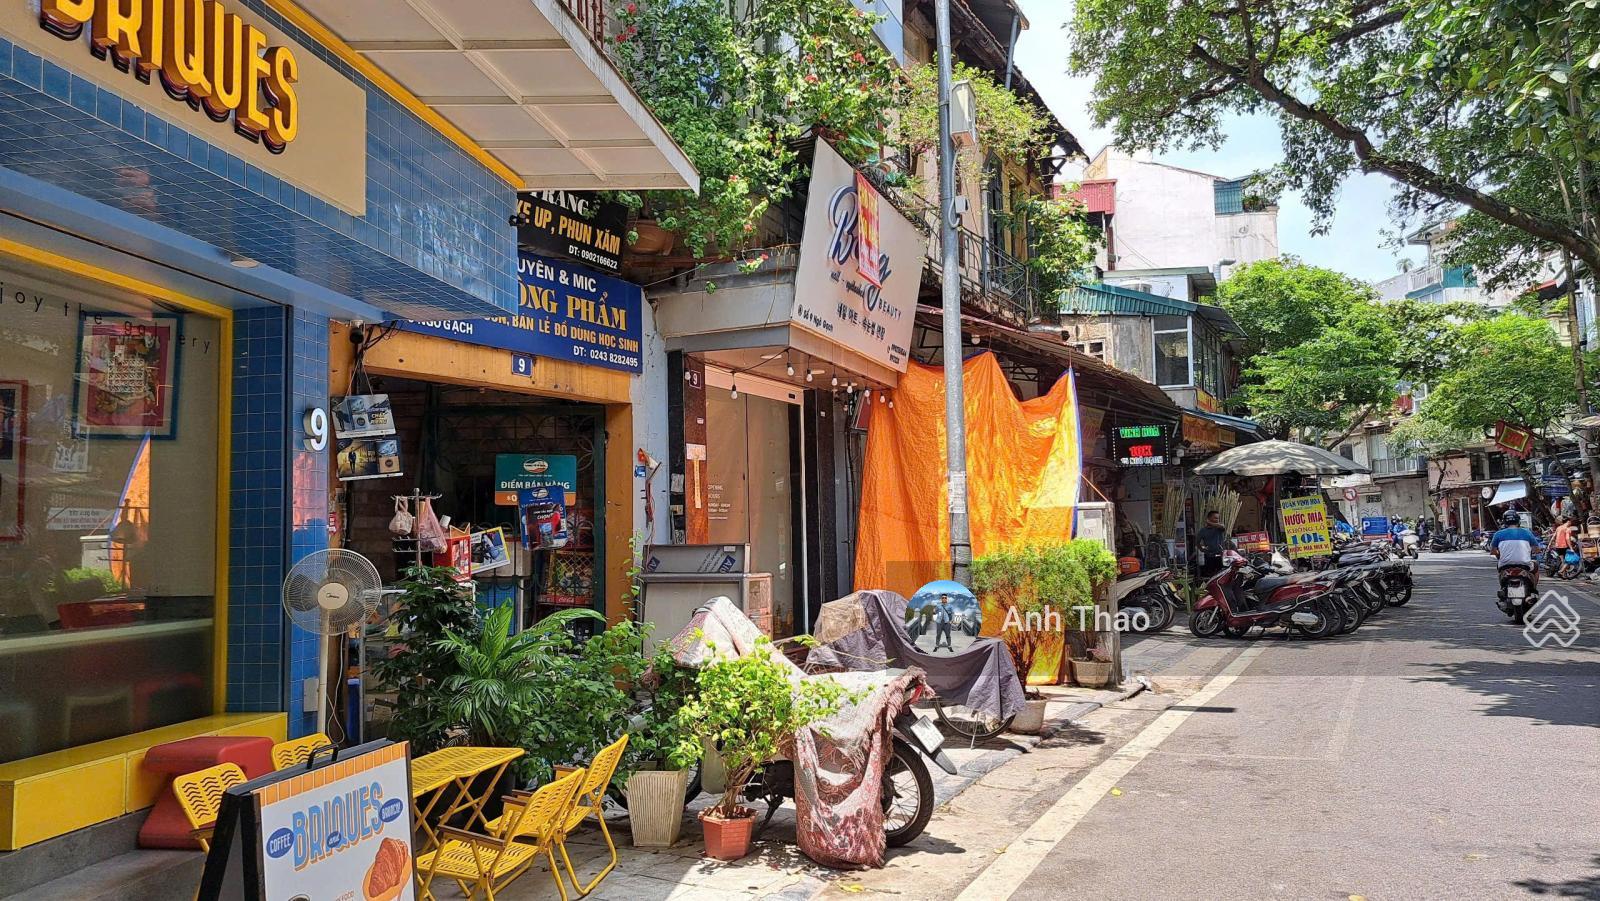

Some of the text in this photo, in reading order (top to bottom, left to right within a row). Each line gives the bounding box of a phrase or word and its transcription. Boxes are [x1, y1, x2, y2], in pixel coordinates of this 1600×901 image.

[50, 0, 298, 143] RIQUES
[530, 190, 589, 216] RANG
[559, 215, 592, 245] PHUN
[595, 228, 621, 256] XĂM
[558, 269, 569, 286] &
[573, 273, 597, 293] MIC
[63, 302, 103, 325] the
[566, 291, 627, 331] PHẨM
[878, 298, 902, 320] BEAUTY
[443, 320, 473, 335] GẠCH
[512, 313, 534, 331] BÁN
[599, 333, 616, 349] HỌC
[619, 338, 639, 353] SINH
[518, 358, 526, 372] 9
[574, 346, 638, 367] ĐT: 0243 8282495
[692, 373, 698, 385] 9
[307, 408, 328, 451] 9
[501, 479, 523, 489] ĐIỂM
[1362, 521, 1371, 531] P
[292, 781, 384, 872] BRIQUES
[269, 832, 291, 854] COFFEE
